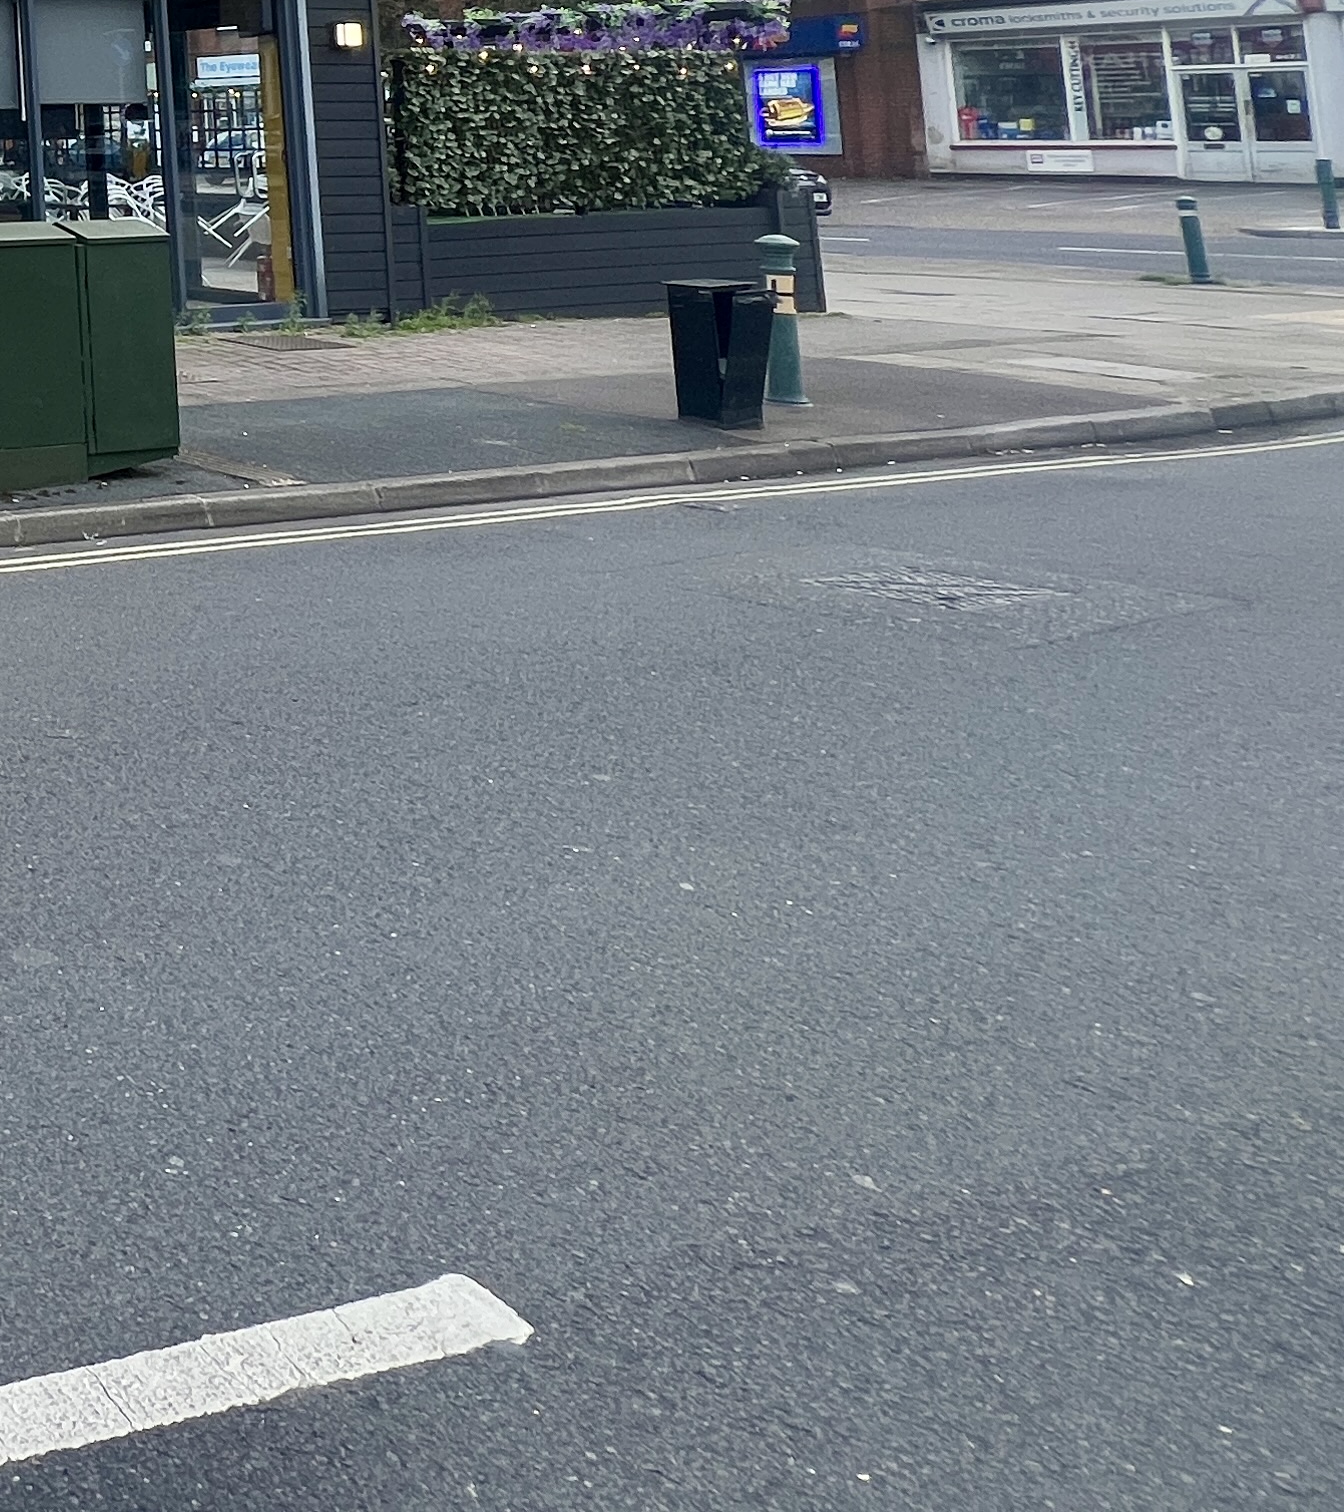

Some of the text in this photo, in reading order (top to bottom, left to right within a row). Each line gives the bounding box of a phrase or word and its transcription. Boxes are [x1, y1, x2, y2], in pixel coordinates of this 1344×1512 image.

[950, 0, 1236, 27] croma locksmiths & security solutions
[200, 62, 217, 73] The
[1073, 94, 1084, 112] KEY
